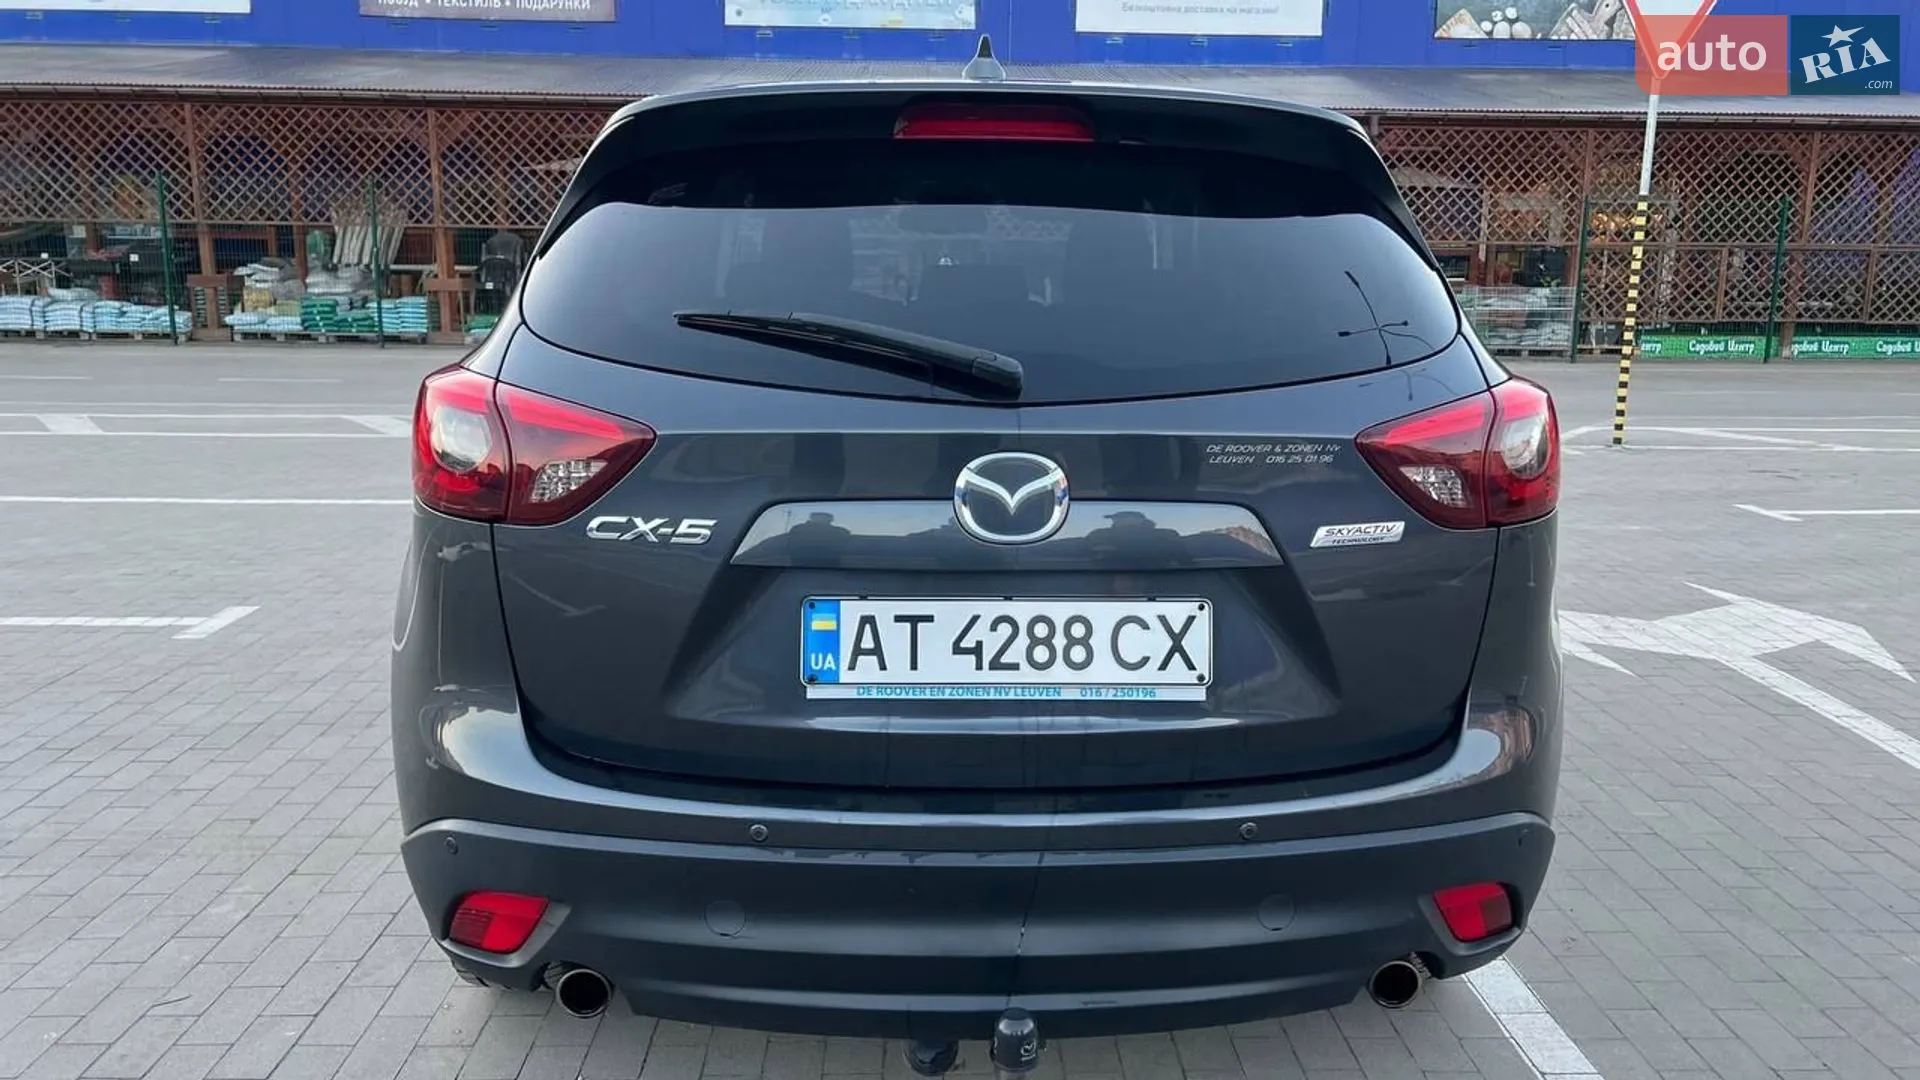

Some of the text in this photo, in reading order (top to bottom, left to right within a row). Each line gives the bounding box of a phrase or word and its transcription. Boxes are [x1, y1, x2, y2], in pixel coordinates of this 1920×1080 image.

[516, 0, 591, 11] ПОДАРУНКИ
[1689, 340, 1755, 355] Садовий Центр
[1822, 341, 1849, 355] Центр
[1876, 341, 1912, 355] Садовий
[1206, 444, 1224, 453] DE
[1225, 444, 1272, 453] ROOVER
[1284, 444, 1323, 453] ZONEN
[1209, 455, 1256, 464] LEUVEN
[1266, 455, 1286, 464] 016
[1287, 455, 1303, 463] 25
[1304, 455, 1318, 463] 01
[586, 515, 718, 545] CX-5
[1324, 524, 1396, 537] SKYACTIV
[847, 613, 1197, 672] AT 4288 CX
[811, 653, 837, 670] UA
[857, 685, 873, 697] DE
[875, 685, 928, 697] ROOVER
[930, 685, 946, 697] EN
[948, 685, 992, 697] ZONEN
[993, 685, 1011, 697] NV
[1013, 686, 1062, 697] LEUVEN
[1080, 687, 1103, 698] 016
[1111, 687, 1157, 698] 250196
